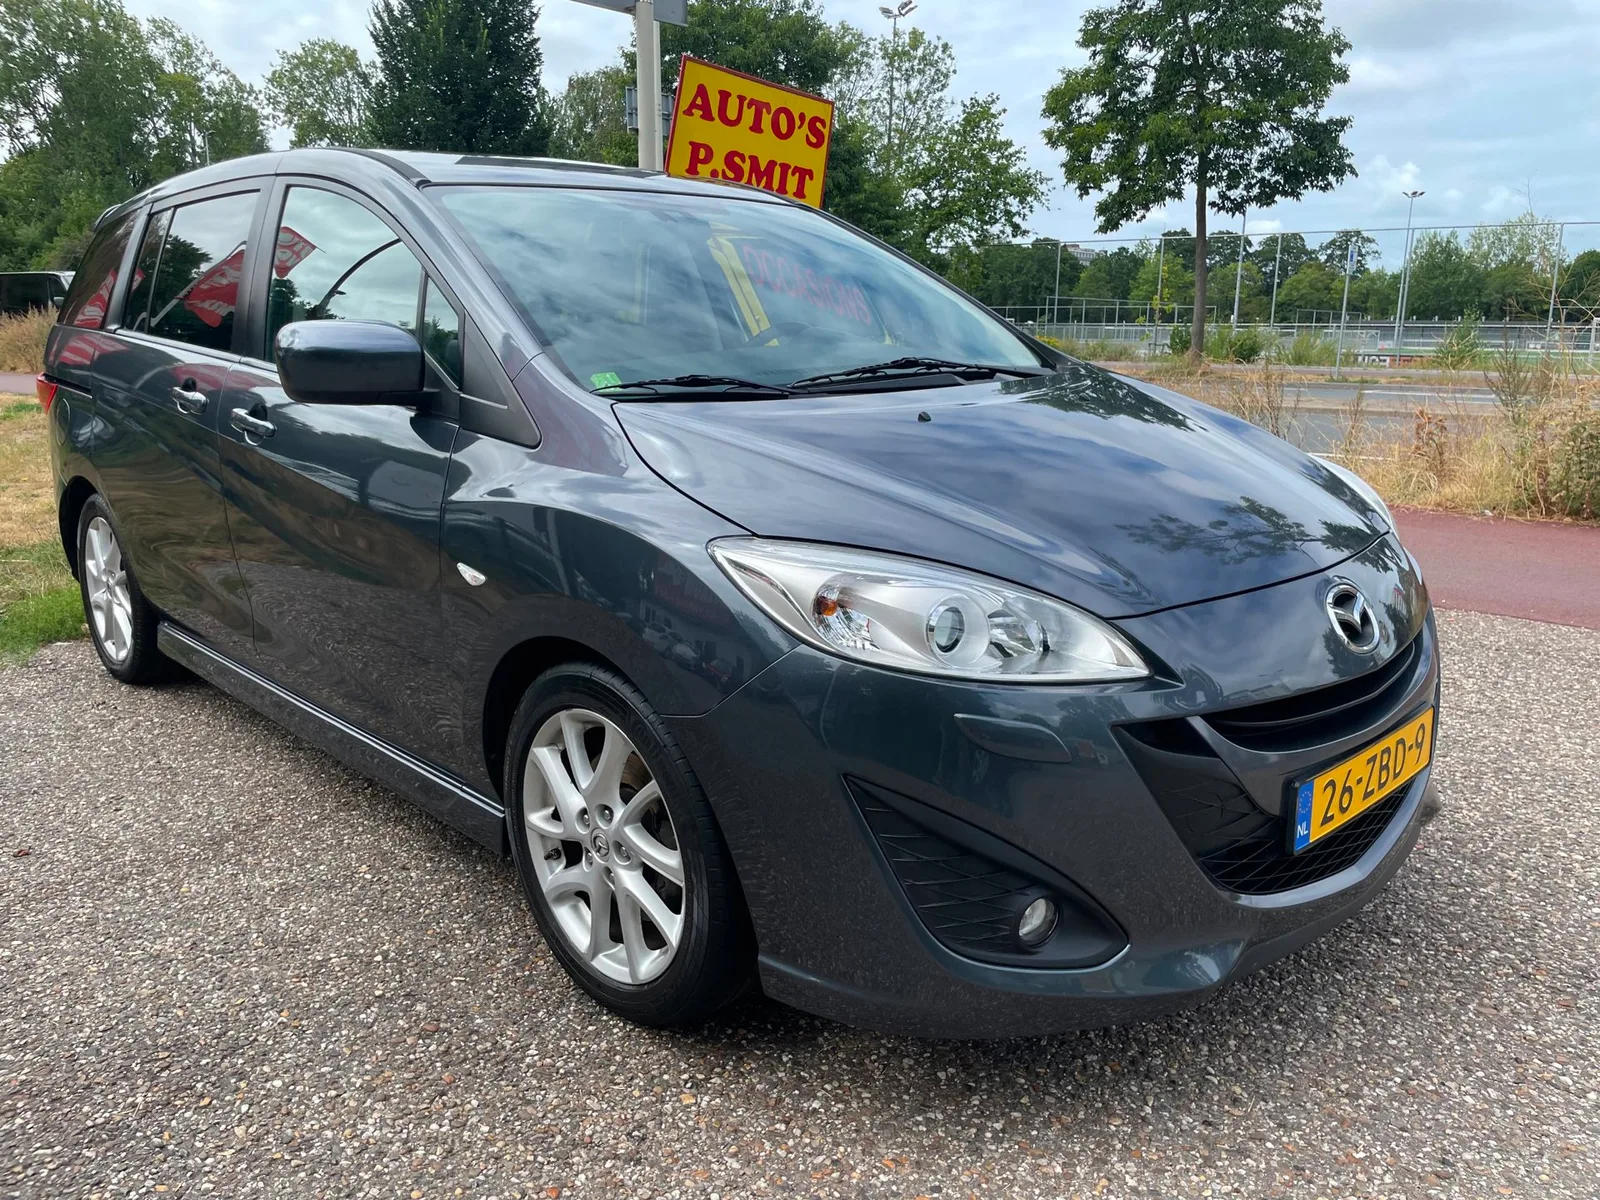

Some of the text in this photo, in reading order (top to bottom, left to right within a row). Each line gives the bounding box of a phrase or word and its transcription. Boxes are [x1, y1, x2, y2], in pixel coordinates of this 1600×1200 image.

[682, 83, 827, 149] AUTO'S
[685, 141, 814, 199] P.SMIT
[742, 244, 872, 326] OCCASIONS
[1320, 722, 1426, 827] 26-ZBD-9
[1297, 821, 1308, 838] NL
